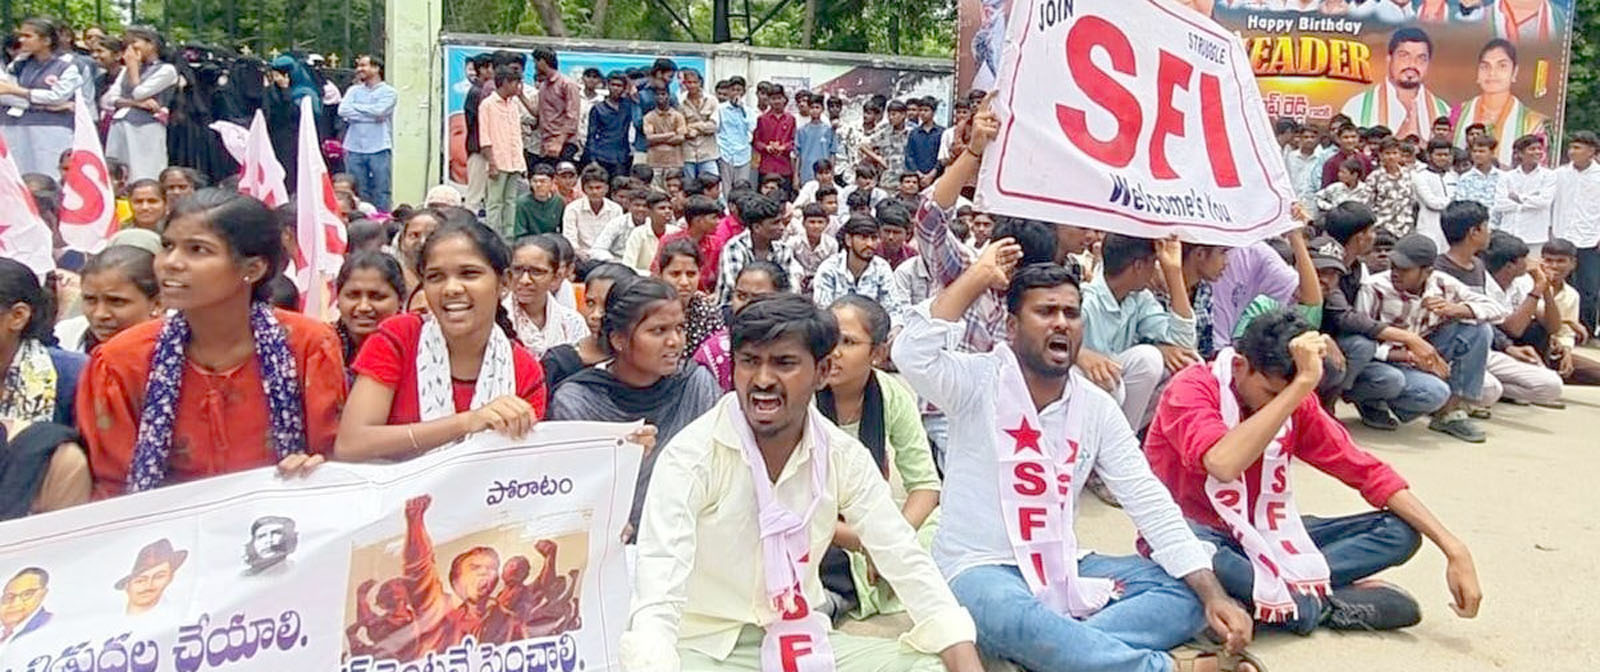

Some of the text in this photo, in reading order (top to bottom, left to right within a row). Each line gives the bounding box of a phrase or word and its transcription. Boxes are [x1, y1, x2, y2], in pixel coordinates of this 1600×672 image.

[1039, 0, 1073, 32] JOIN
[1247, 15, 1361, 35] Happy Birthday
[1188, 32, 1225, 65] STRUGGLE
[1246, 33, 1372, 82] EADER
[1056, 14, 1242, 188] SFI
[1109, 173, 1233, 222] Welcome's You
[486, 475, 573, 506] పోరాటం
